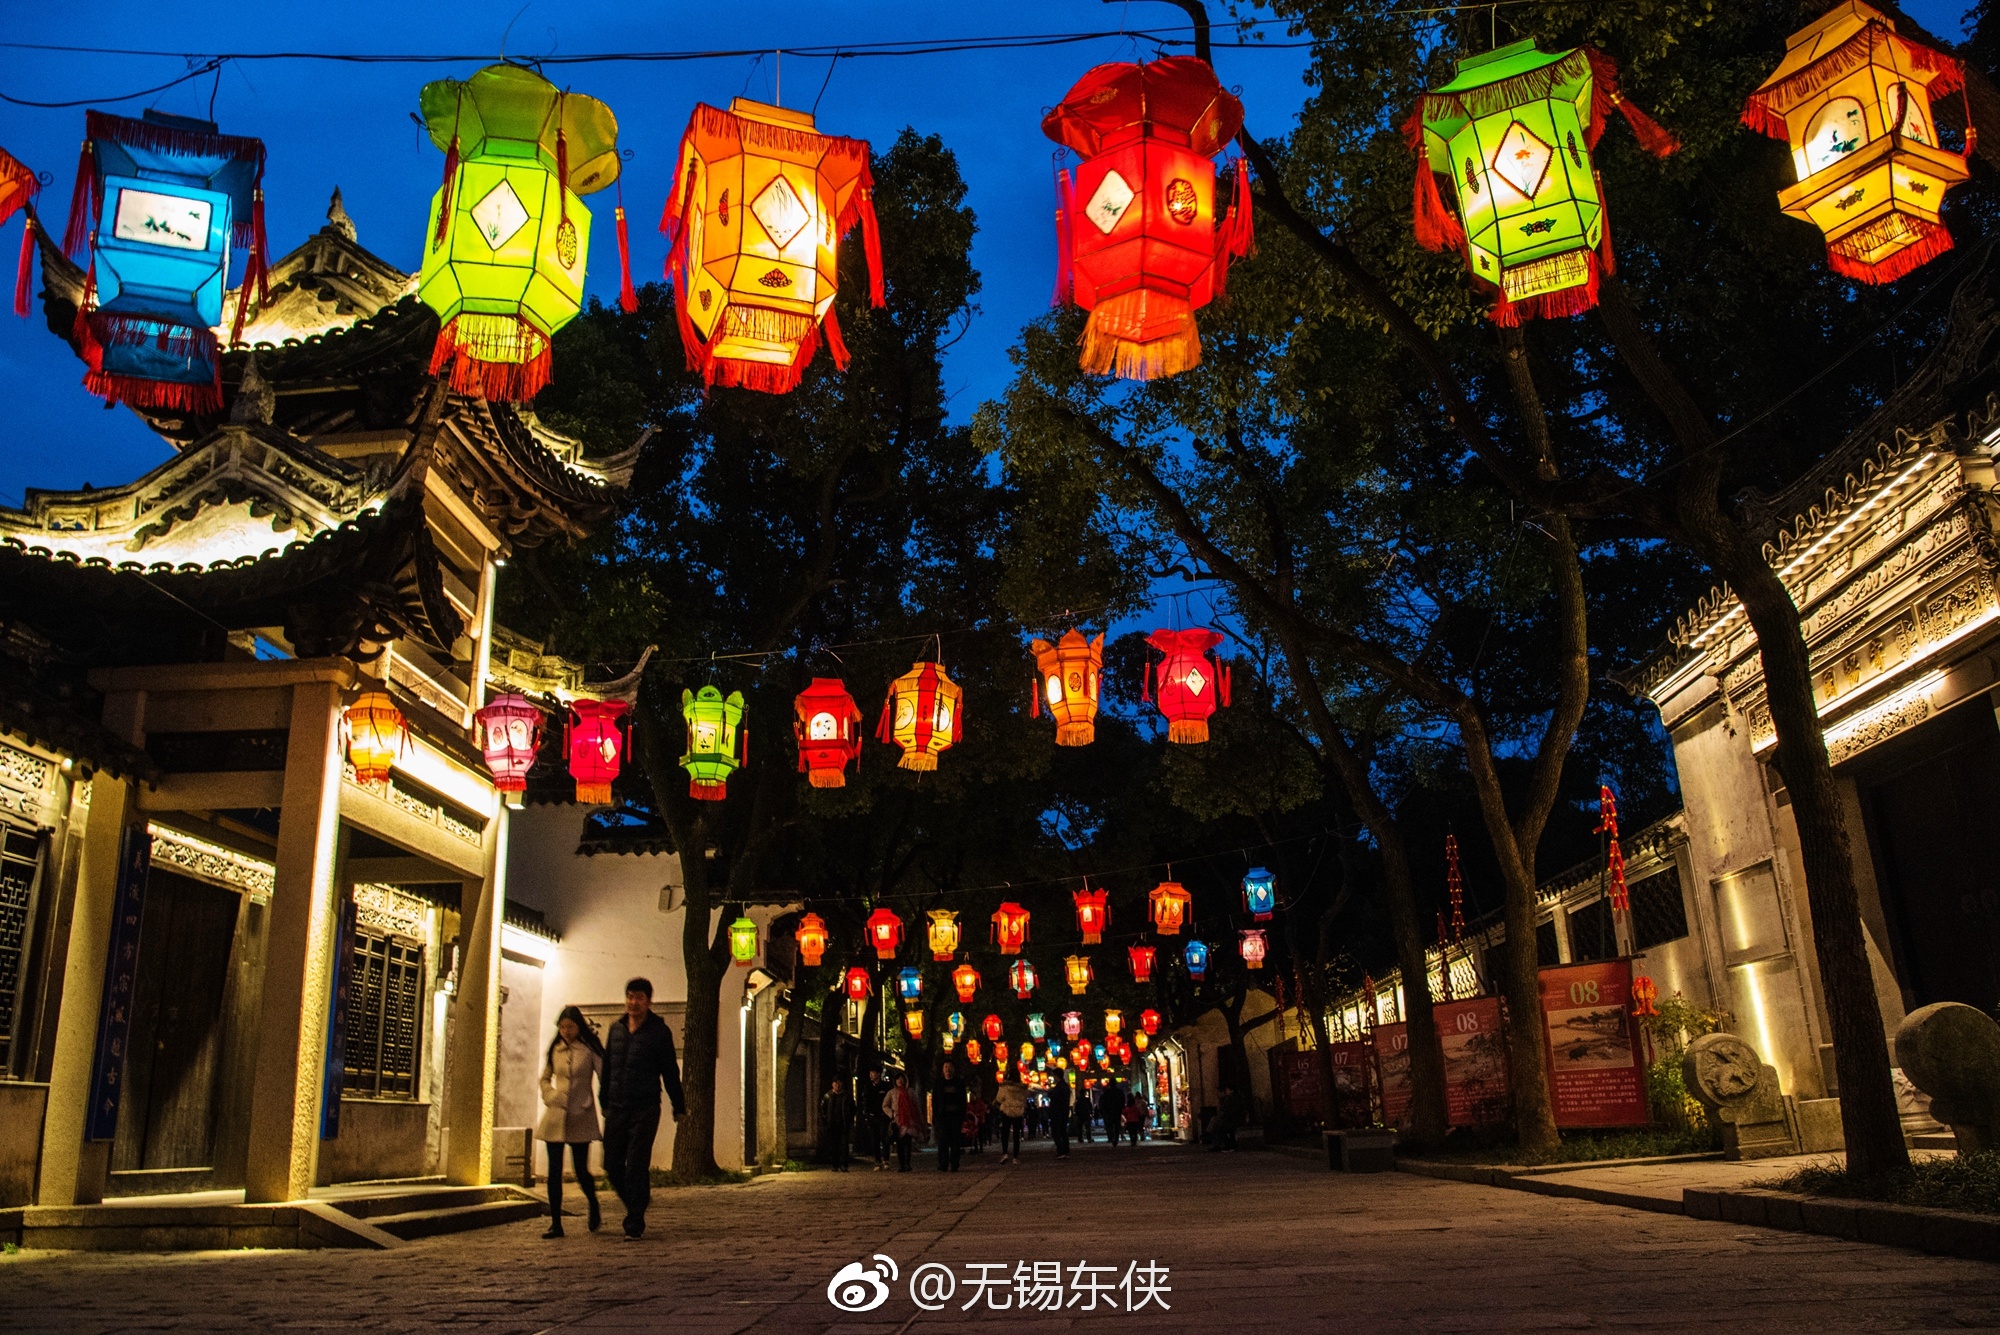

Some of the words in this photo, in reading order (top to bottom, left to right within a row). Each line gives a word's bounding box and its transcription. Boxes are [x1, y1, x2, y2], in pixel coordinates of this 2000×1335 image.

[1570, 980, 1600, 1005] 08
[1456, 1011, 1478, 1032] 08
[1392, 1034, 1408, 1050] 07
[1334, 1052, 1349, 1065] 07
